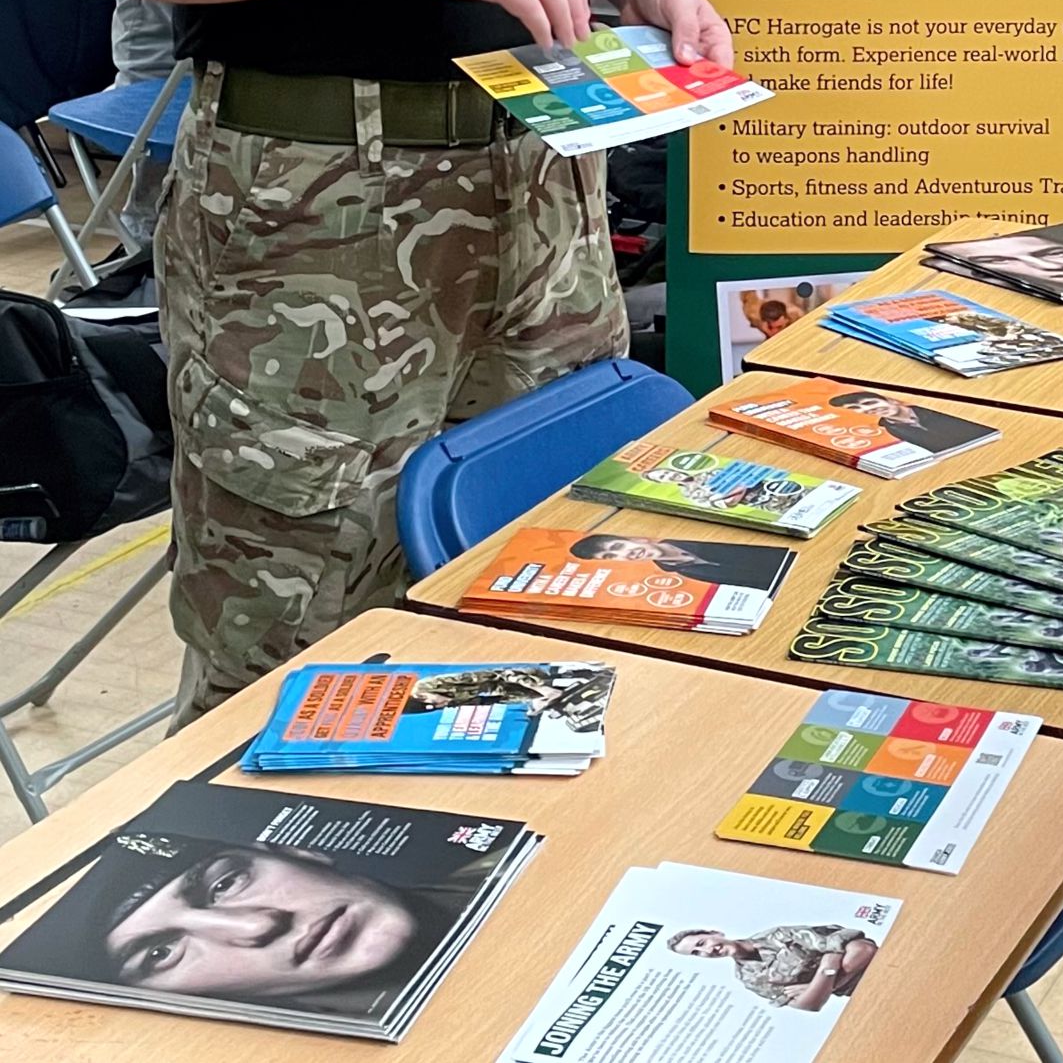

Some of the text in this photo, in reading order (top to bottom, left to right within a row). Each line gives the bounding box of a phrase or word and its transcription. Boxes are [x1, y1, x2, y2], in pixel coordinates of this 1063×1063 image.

[767, 19, 860, 38] Harrogate
[867, 19, 882, 34] is
[889, 20, 919, 34] not
[925, 23, 968, 37] your
[974, 17, 1057, 37] everyday
[744, 46, 790, 62] sixth
[797, 46, 845, 62] form.
[852, 46, 956, 65] Experience
[963, 45, 1057, 61] real-world
[760, 74, 810, 91] make
[817, 74, 882, 90] friends
[889, 74, 914, 90] for
[920, 73, 952, 89] life!
[733, 118, 1049, 139] Military training: outdoor survival
[733, 146, 929, 166] to weapons handling
[732, 179, 798, 198] Sports,
[805, 179, 868, 195] fitness
[873, 178, 908, 194] and
[915, 178, 1033, 194] Adventurous
[732, 211, 826, 227] Education
[833, 210, 867, 226] and
[874, 210, 969, 226] leadershi
[540, 923, 657, 1056] JOINING THE ARMY
